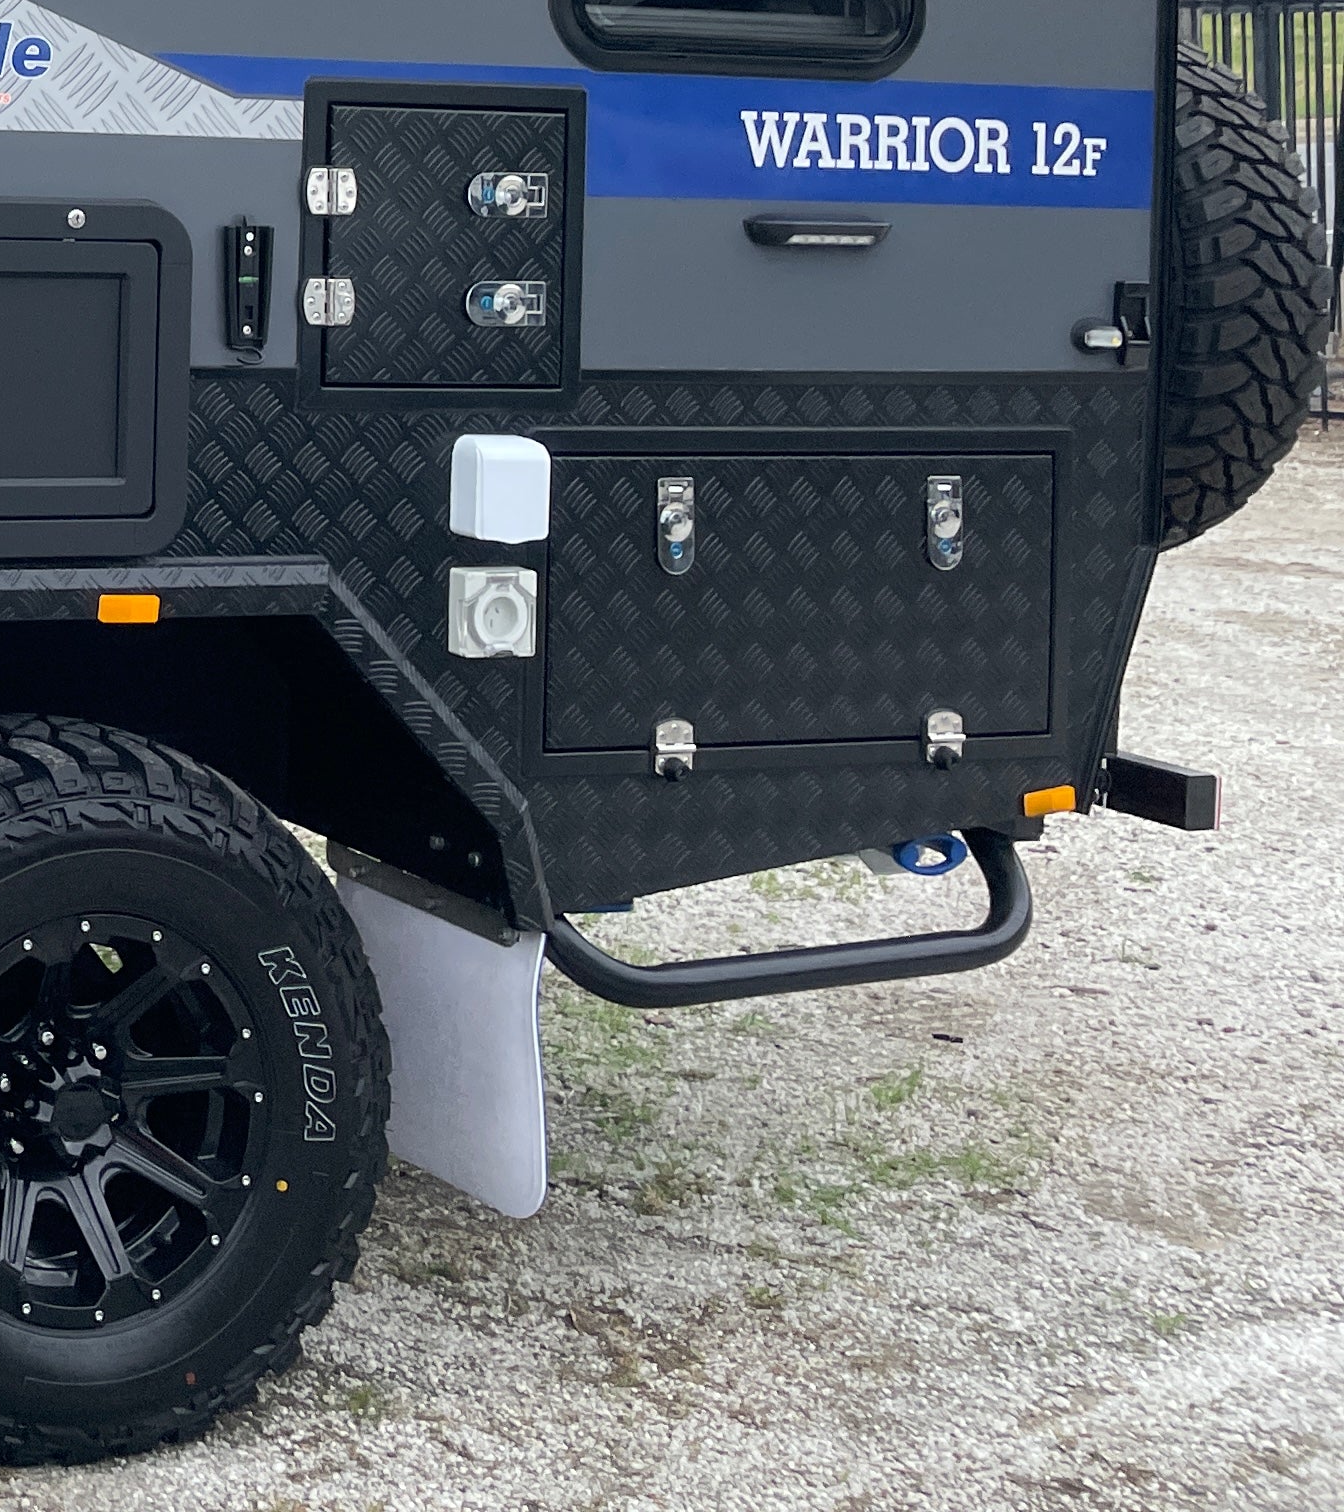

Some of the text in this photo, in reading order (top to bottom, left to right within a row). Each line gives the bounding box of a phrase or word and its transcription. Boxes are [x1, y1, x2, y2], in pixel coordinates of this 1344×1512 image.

[740, 110, 1107, 177] WARRIOR 12F
[258, 946, 337, 1142] KENDA
